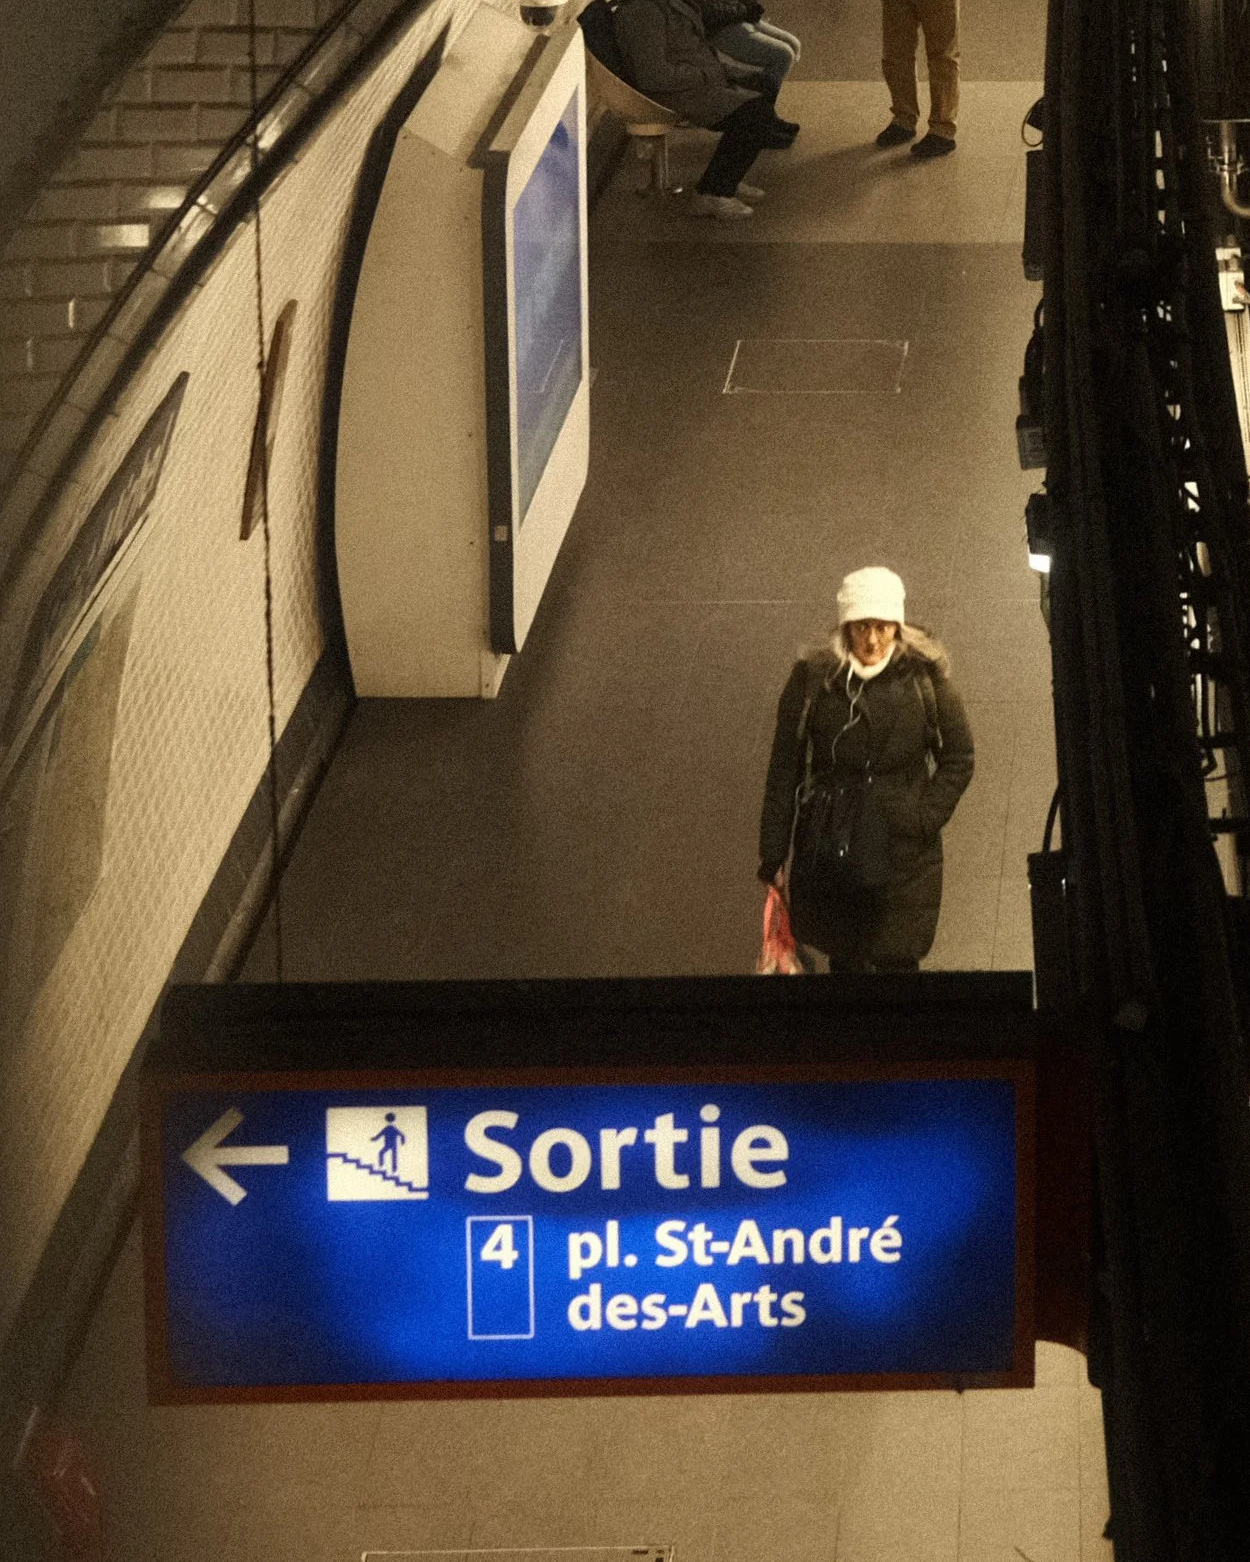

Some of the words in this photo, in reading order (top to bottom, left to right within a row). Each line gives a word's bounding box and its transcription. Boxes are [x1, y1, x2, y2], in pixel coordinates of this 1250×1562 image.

[463, 1103, 790, 1194] Sortie
[479, 1222, 520, 1270] 4
[567, 1219, 640, 1281] pl.
[654, 1214, 903, 1268] St-André
[567, 1282, 806, 1332] des-Arts
